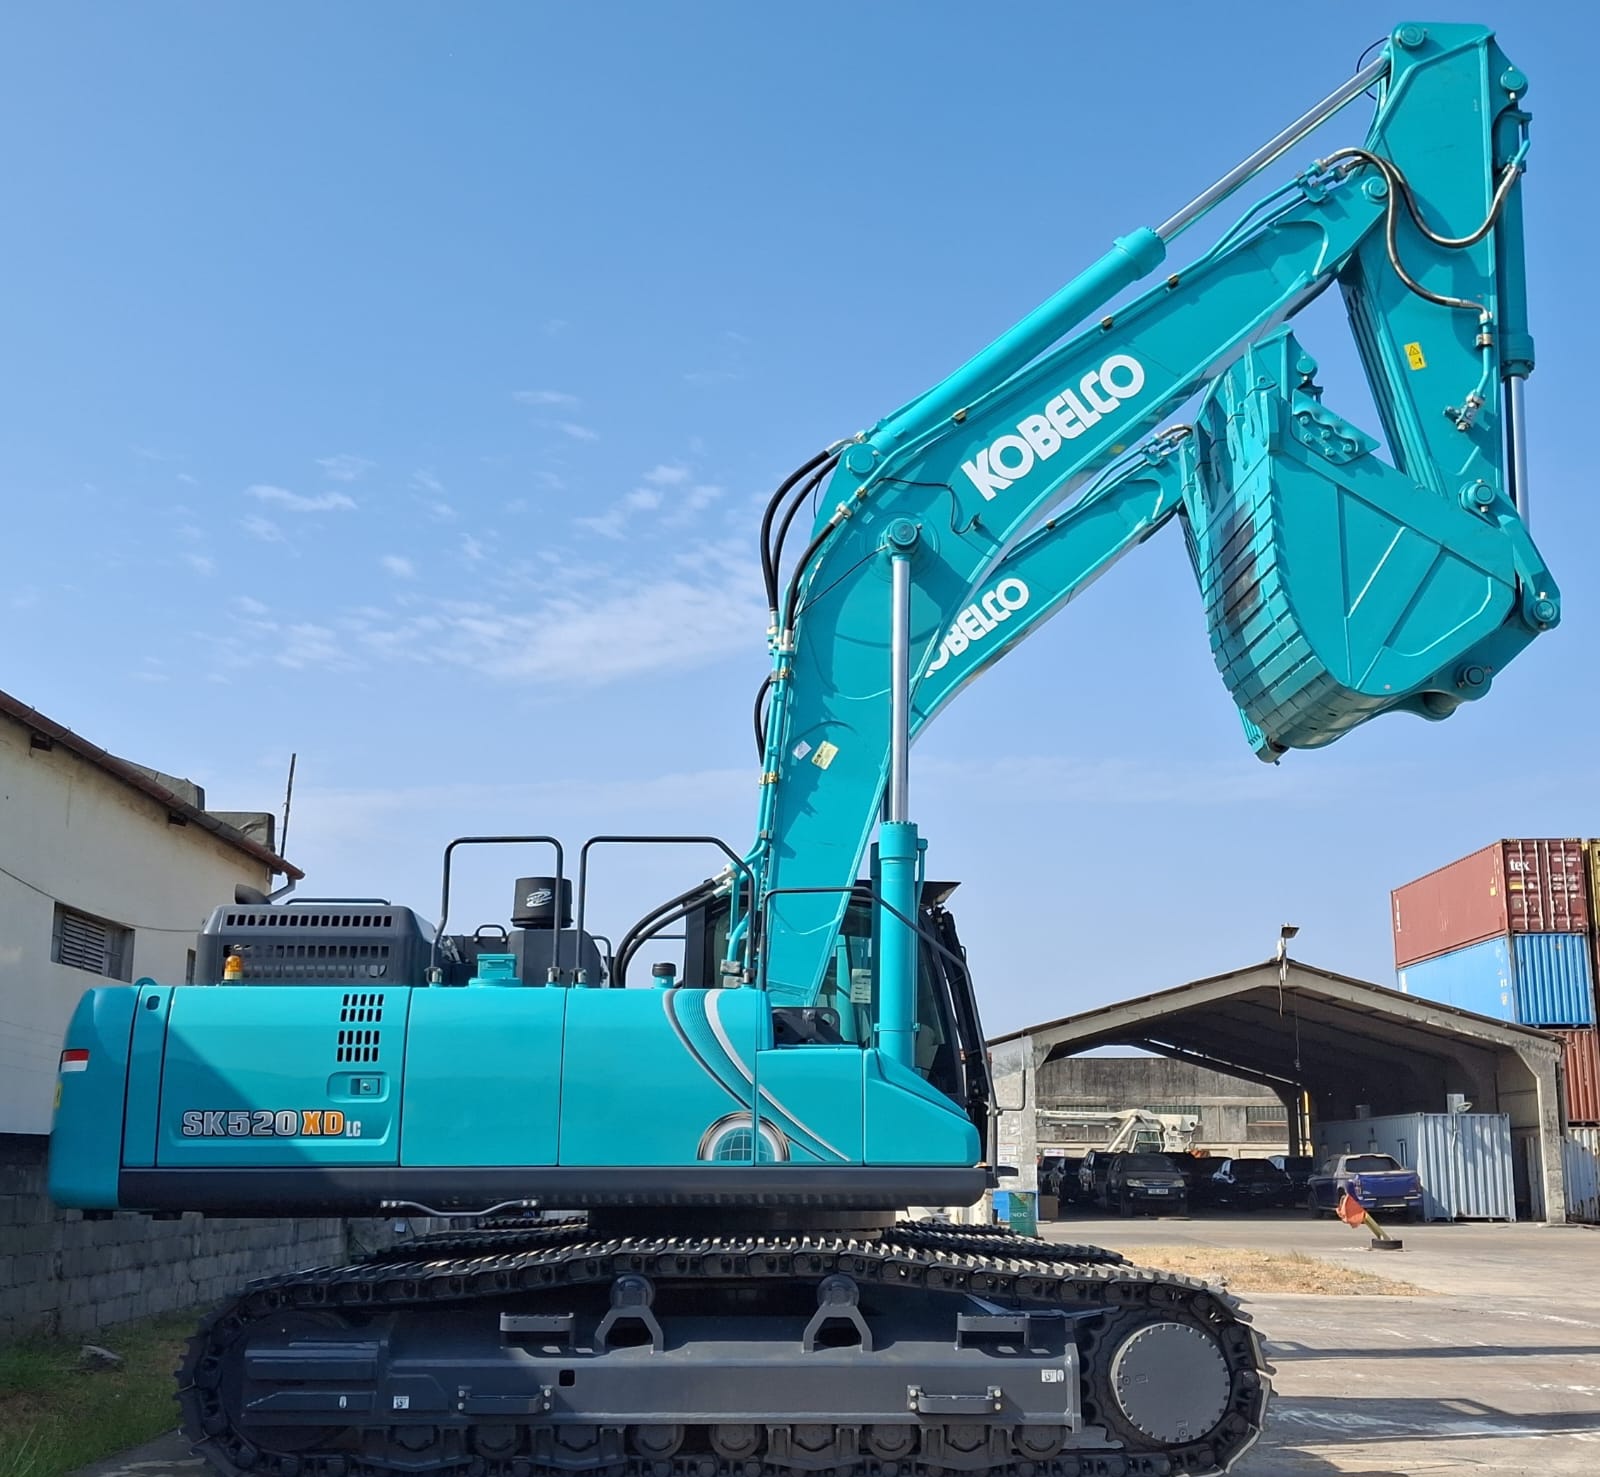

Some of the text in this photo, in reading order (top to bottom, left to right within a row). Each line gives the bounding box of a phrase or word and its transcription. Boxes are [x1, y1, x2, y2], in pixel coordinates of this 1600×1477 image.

[961, 354, 1145, 501] KOBELCO
[924, 578, 1029, 678] BELCO
[182, 1110, 361, 1137] SK520XD LC
